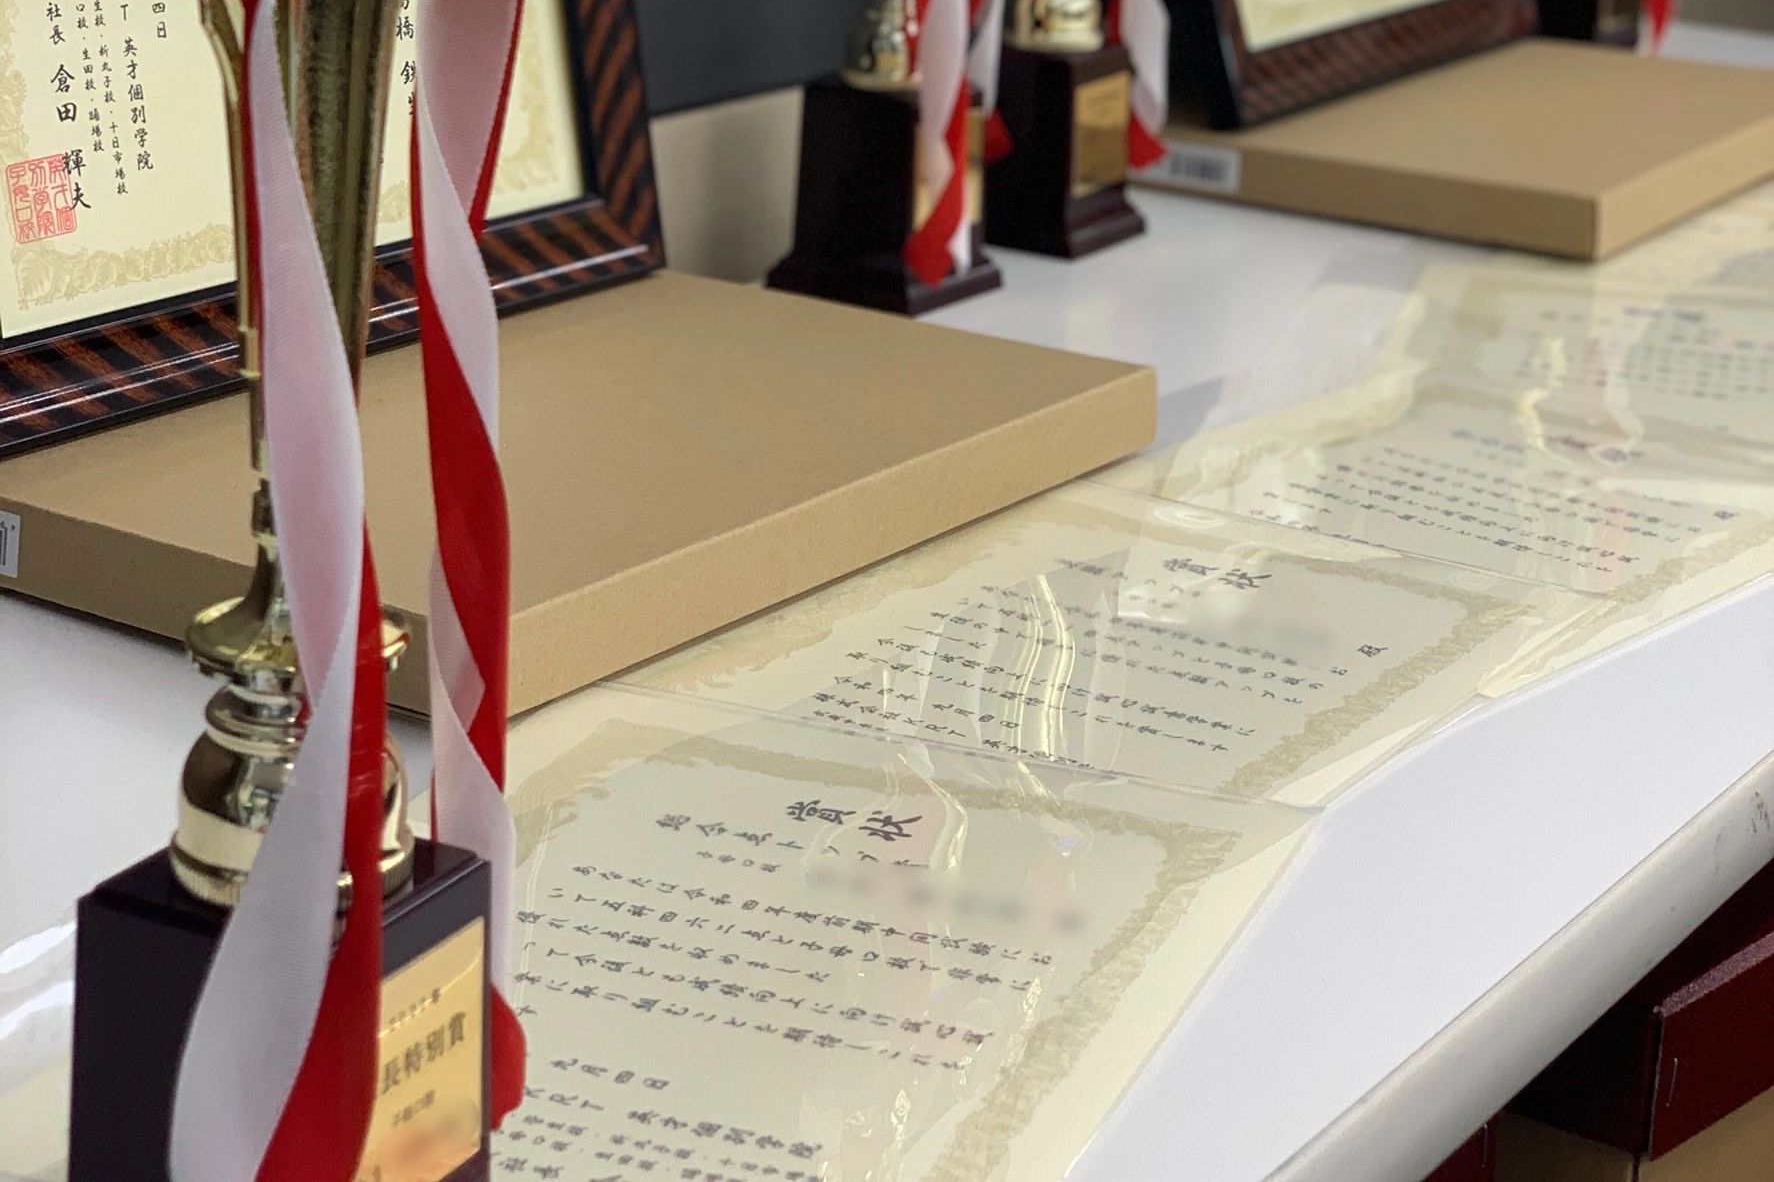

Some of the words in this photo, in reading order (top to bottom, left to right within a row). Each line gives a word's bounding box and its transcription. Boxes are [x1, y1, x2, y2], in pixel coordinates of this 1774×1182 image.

[50, 64, 77, 123] 倉田
[122, 37, 154, 171] 英才個別学院
[62, 149, 92, 211] 輝夫
[1163, 558, 1273, 590] 賞状
[1357, 643, 1389, 658] 殿
[812, 691, 966, 739] 株式会社KRT
[834, 675, 918, 702] 令和四年
[931, 703, 1019, 730] 九月四日
[786, 799, 923, 842] 賞状
[550, 1057, 671, 1091] 九月四日
[627, 1109, 823, 1160] 英才個別学院
